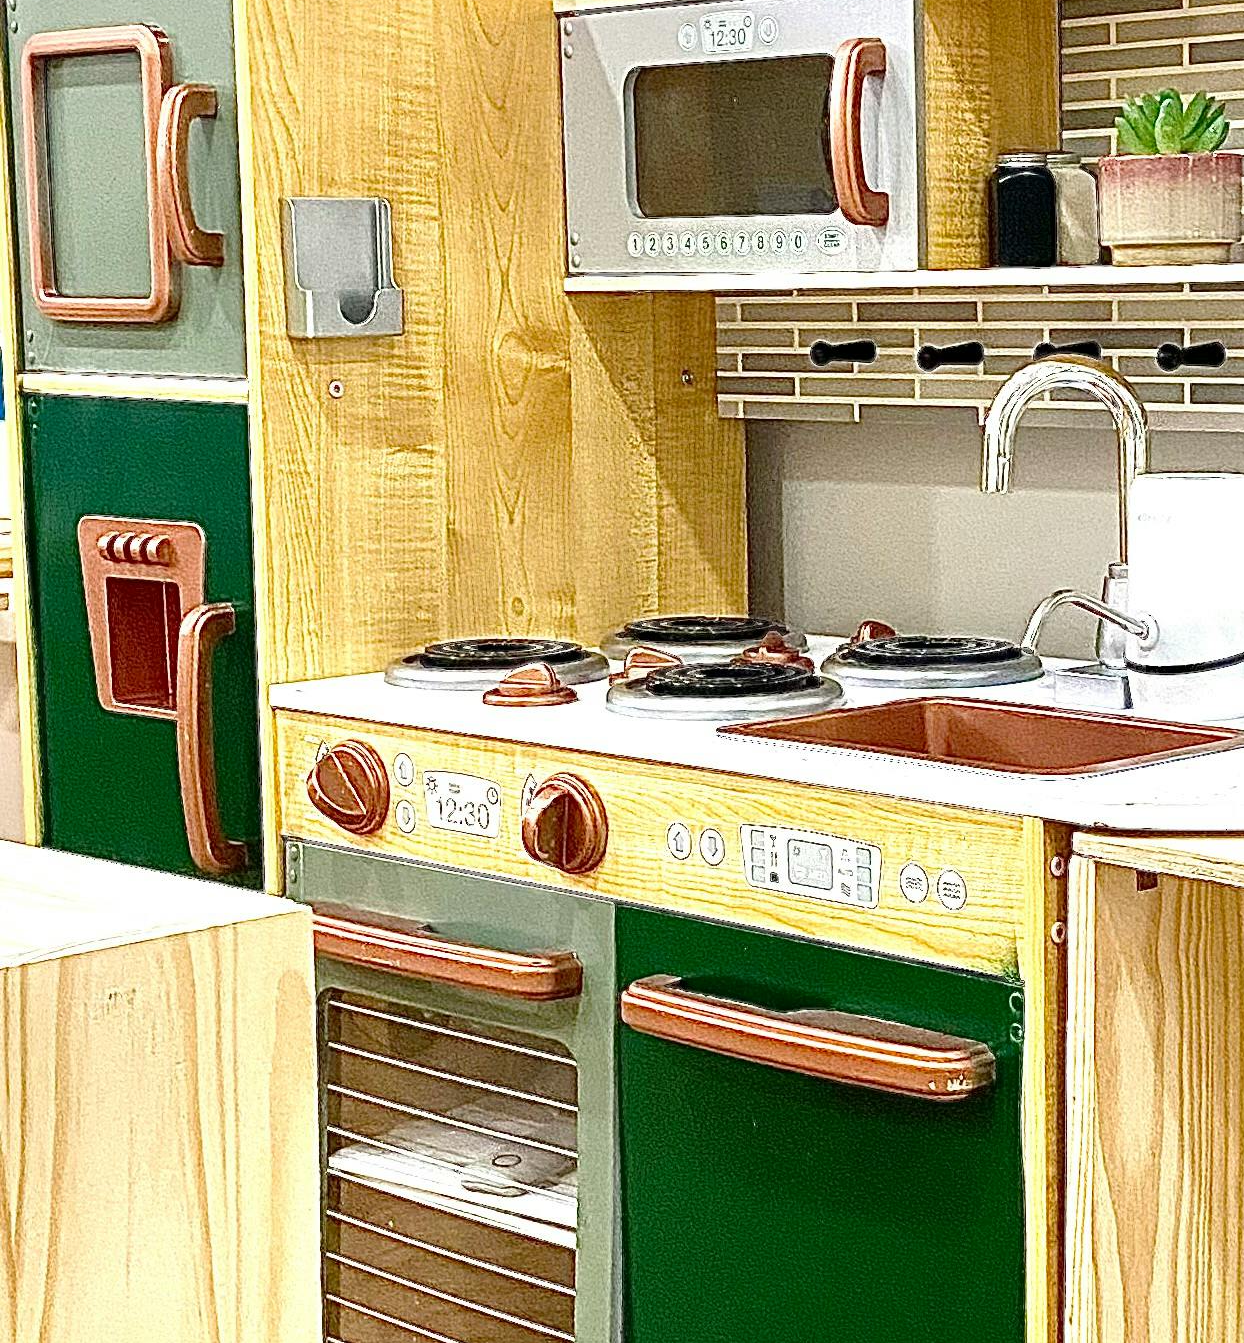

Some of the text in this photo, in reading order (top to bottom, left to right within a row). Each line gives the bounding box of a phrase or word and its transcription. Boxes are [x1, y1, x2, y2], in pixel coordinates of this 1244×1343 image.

[710, 28, 746, 47] 12:30
[632, 235, 802, 251] 1 2 3 4 5 6 7 8 9 0
[436, 797, 490, 830] 12:30
